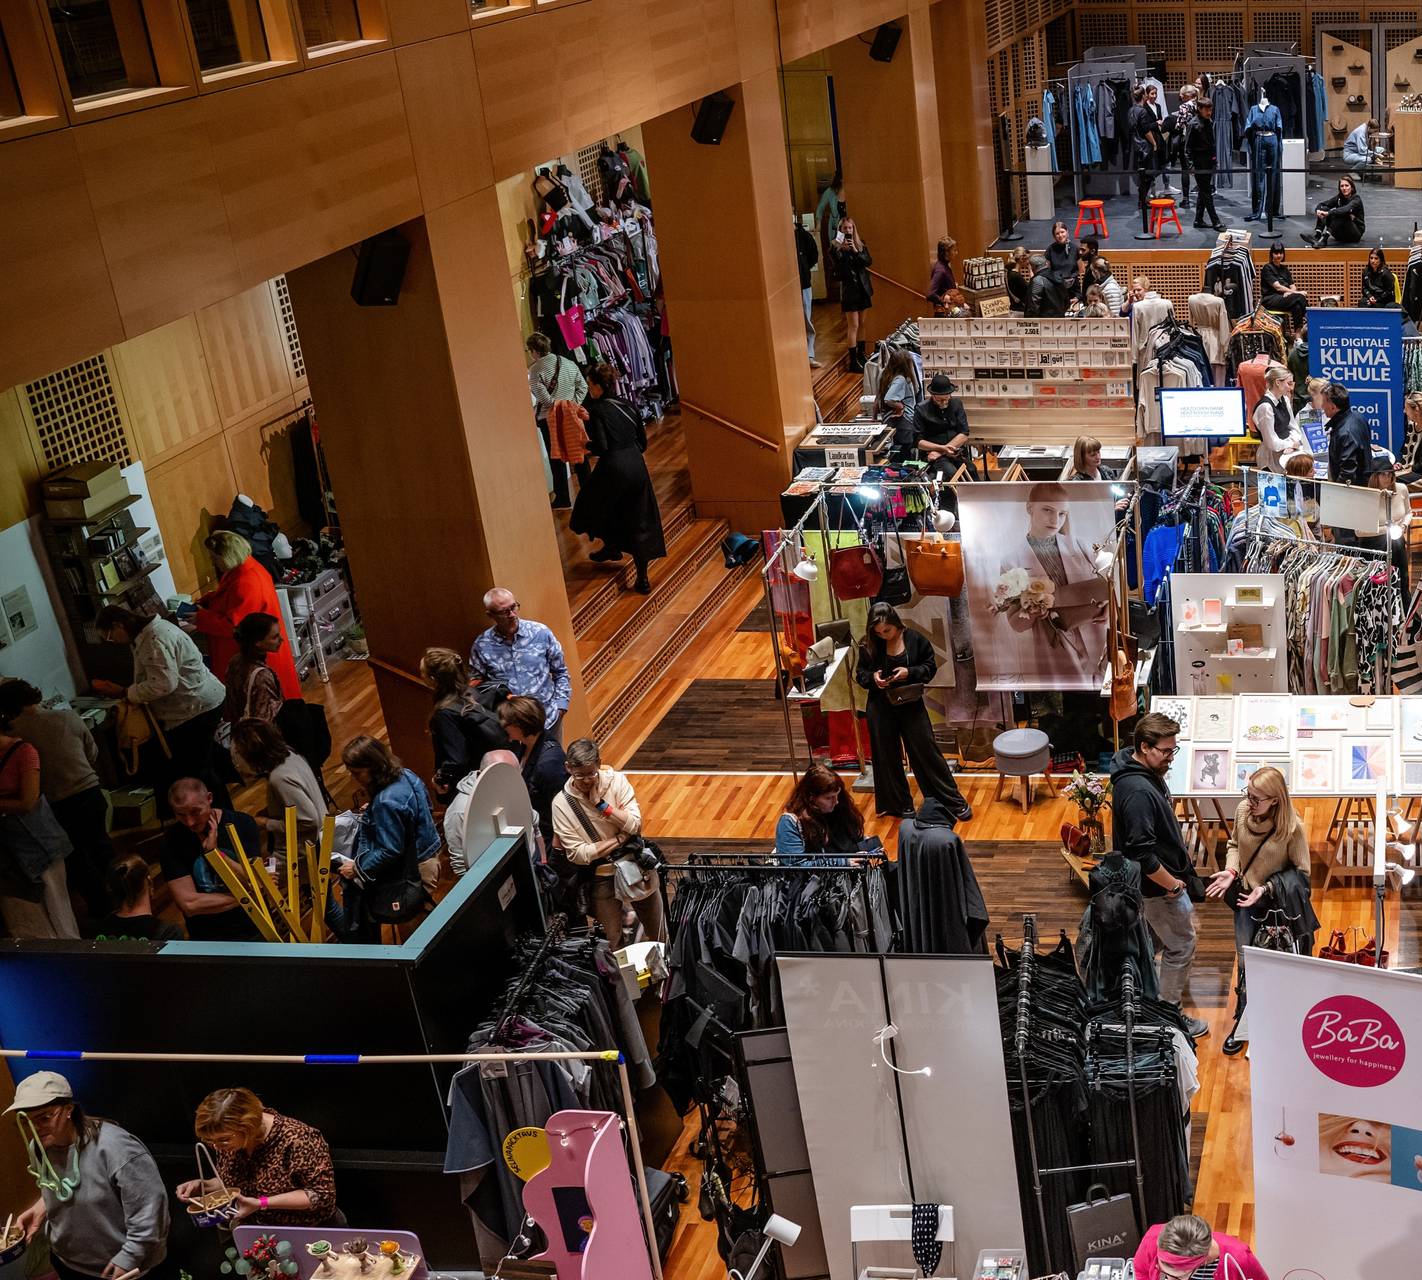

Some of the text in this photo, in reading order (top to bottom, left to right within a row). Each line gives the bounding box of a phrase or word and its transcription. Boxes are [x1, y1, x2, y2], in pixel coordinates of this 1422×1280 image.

[1320, 337, 1390, 348] DIE DIGITALE
[1320, 348, 1390, 366] KLIMA
[1322, 367, 1391, 381] SCHULE
[1351, 403, 1379, 414] cool
[1308, 1010, 1400, 1053] BaBa
[1313, 1053, 1396, 1071] jewellery for happiness
[1088, 1235, 1122, 1250] KINA
